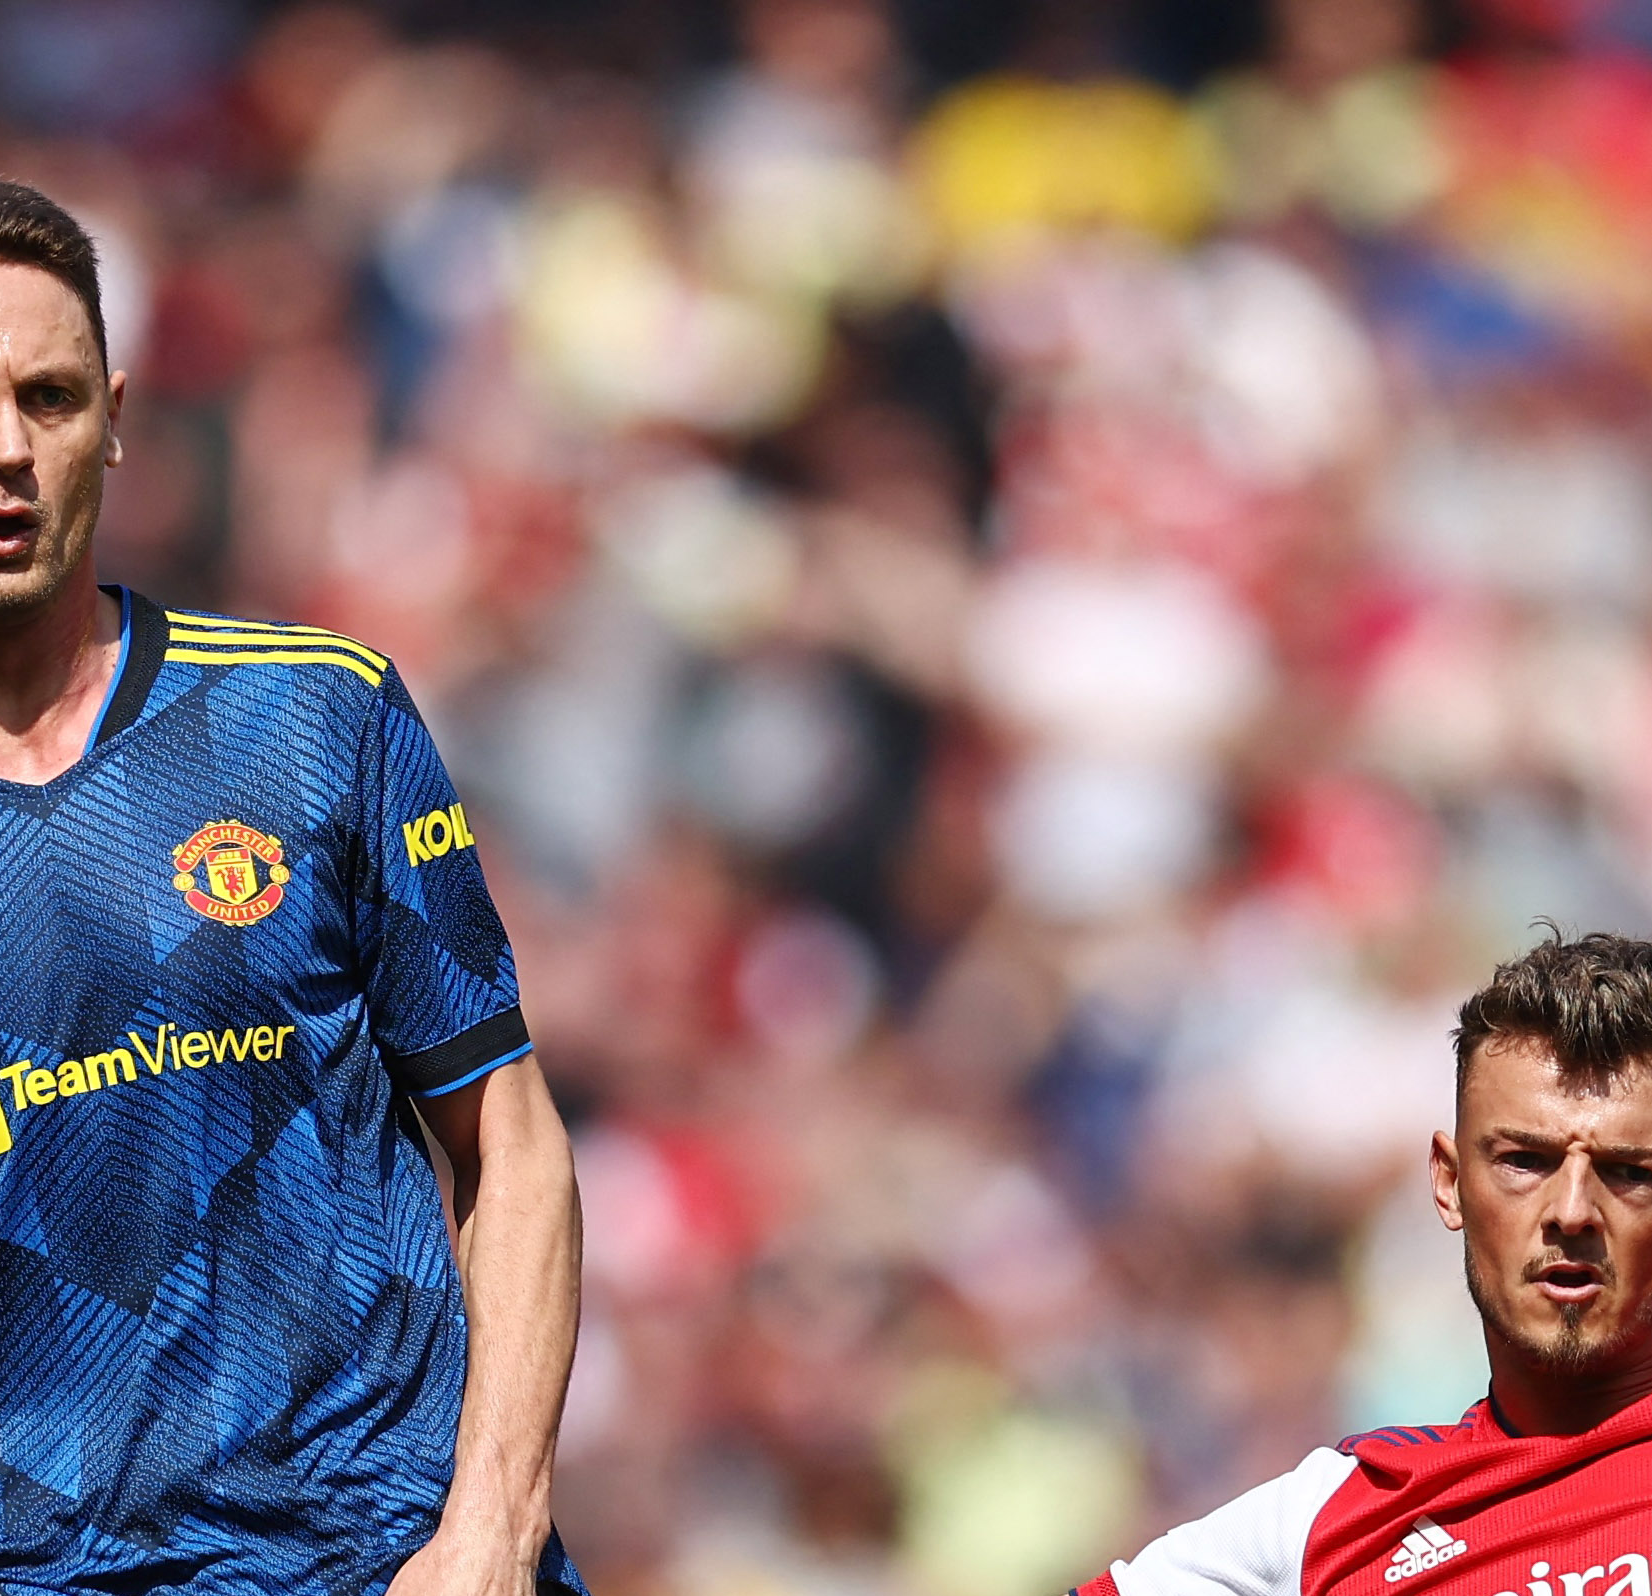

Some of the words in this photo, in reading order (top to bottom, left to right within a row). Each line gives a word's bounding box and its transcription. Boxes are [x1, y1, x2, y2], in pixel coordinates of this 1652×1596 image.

[181, 827, 275, 865] MANCHESTER
[207, 899, 270, 919] UNITED
[1384, 1540, 1468, 1583] adidas
